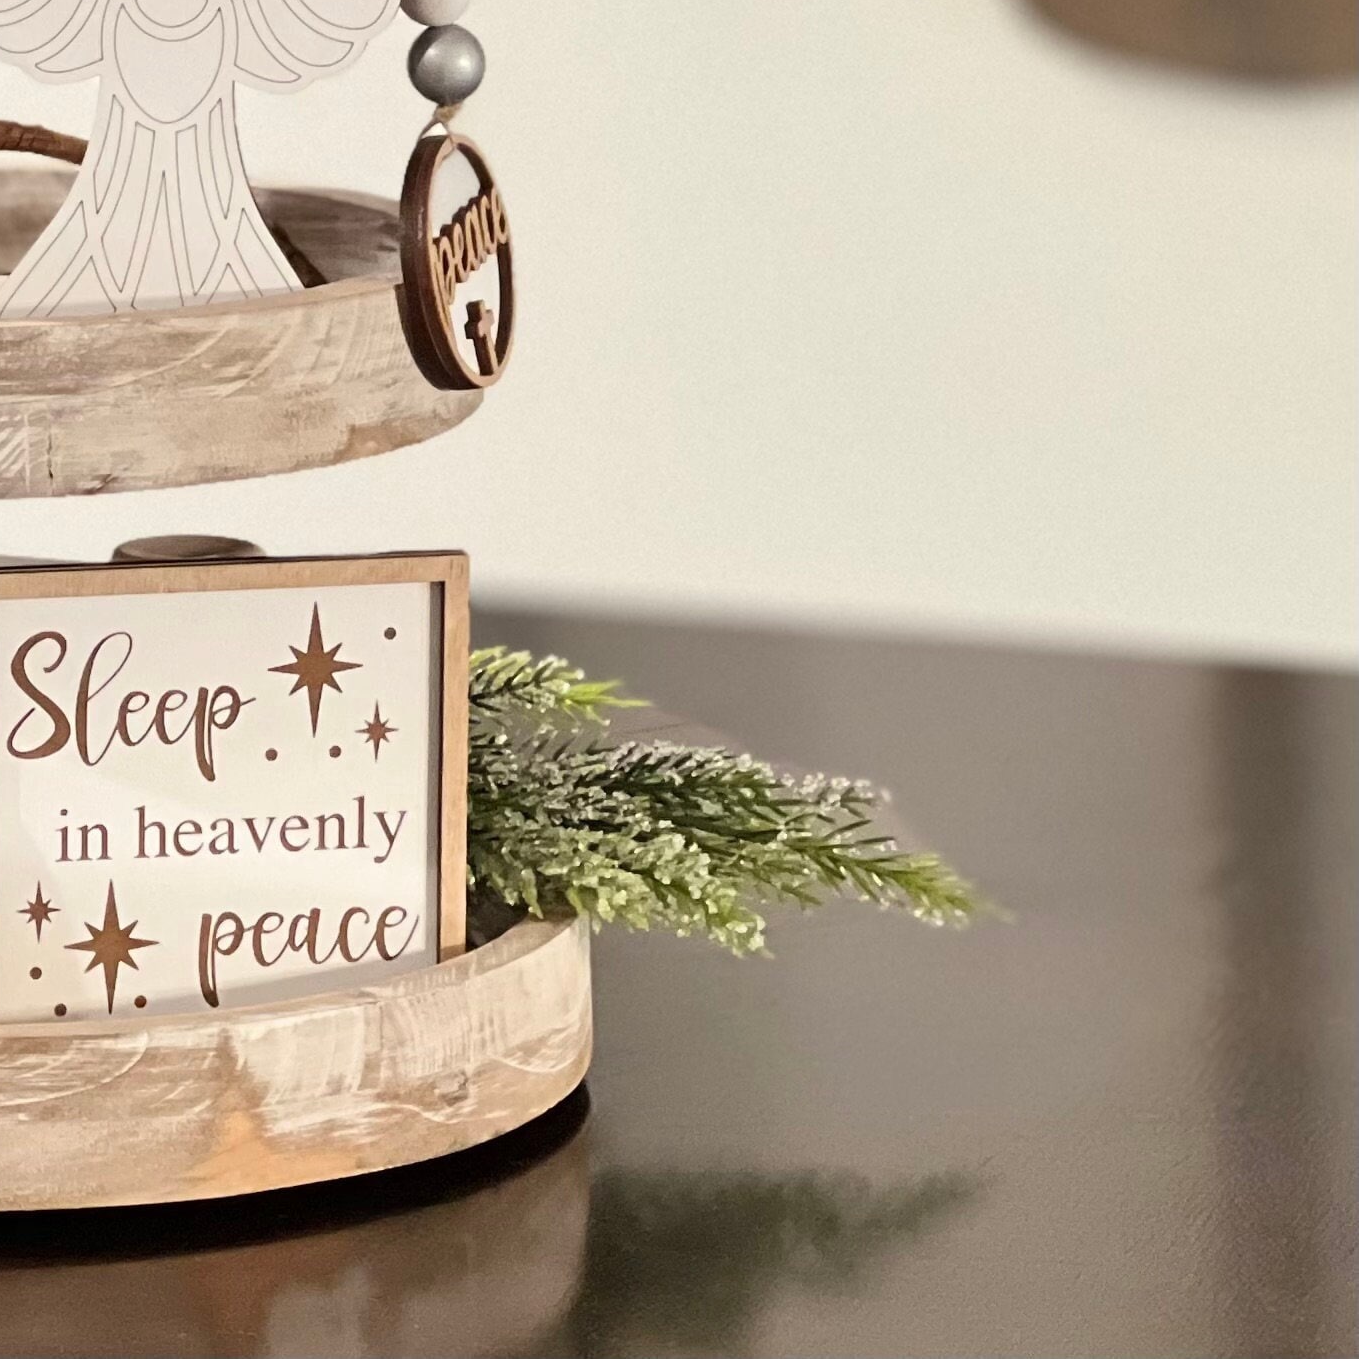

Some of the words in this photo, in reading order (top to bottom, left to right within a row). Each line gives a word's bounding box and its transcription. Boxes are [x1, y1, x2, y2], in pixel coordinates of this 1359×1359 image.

[6, 630, 257, 782] Sleep
[54, 808, 112, 863] in
[134, 795, 408, 864] heavenly
[198, 904, 420, 1008] peace
